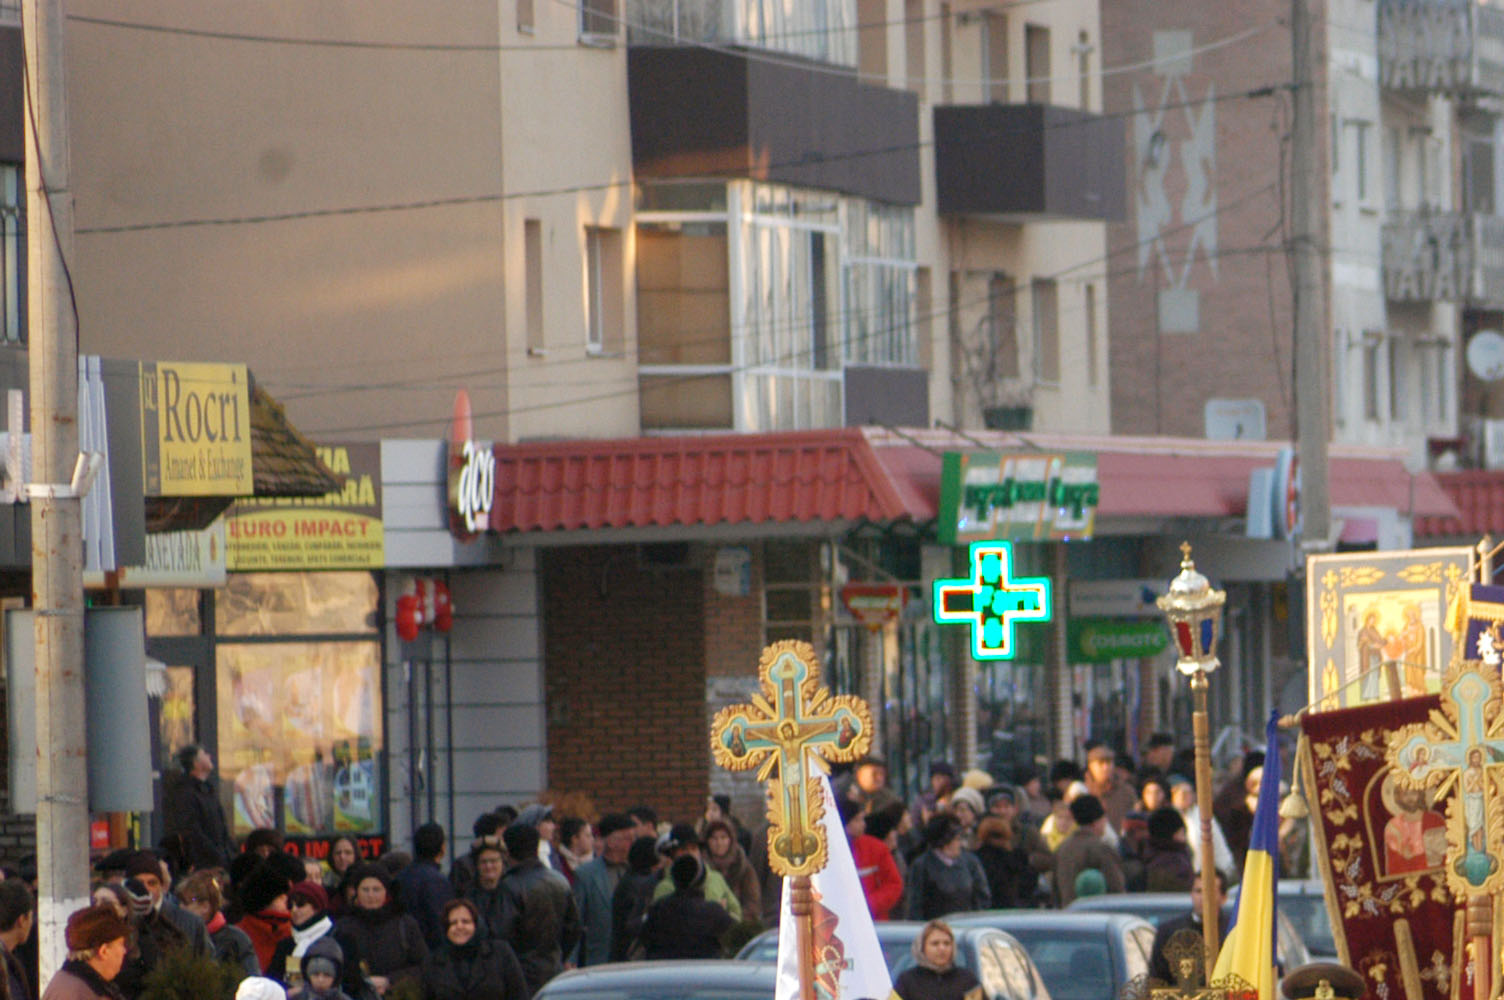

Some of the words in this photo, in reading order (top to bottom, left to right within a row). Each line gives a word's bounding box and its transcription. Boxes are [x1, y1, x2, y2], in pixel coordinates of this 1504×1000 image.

[162, 369, 241, 443] Rocri
[165, 452, 196, 481] Amanet
[207, 449, 245, 491] Exchange
[229, 520, 288, 539] EURO
[294, 518, 369, 538] IMPACT
